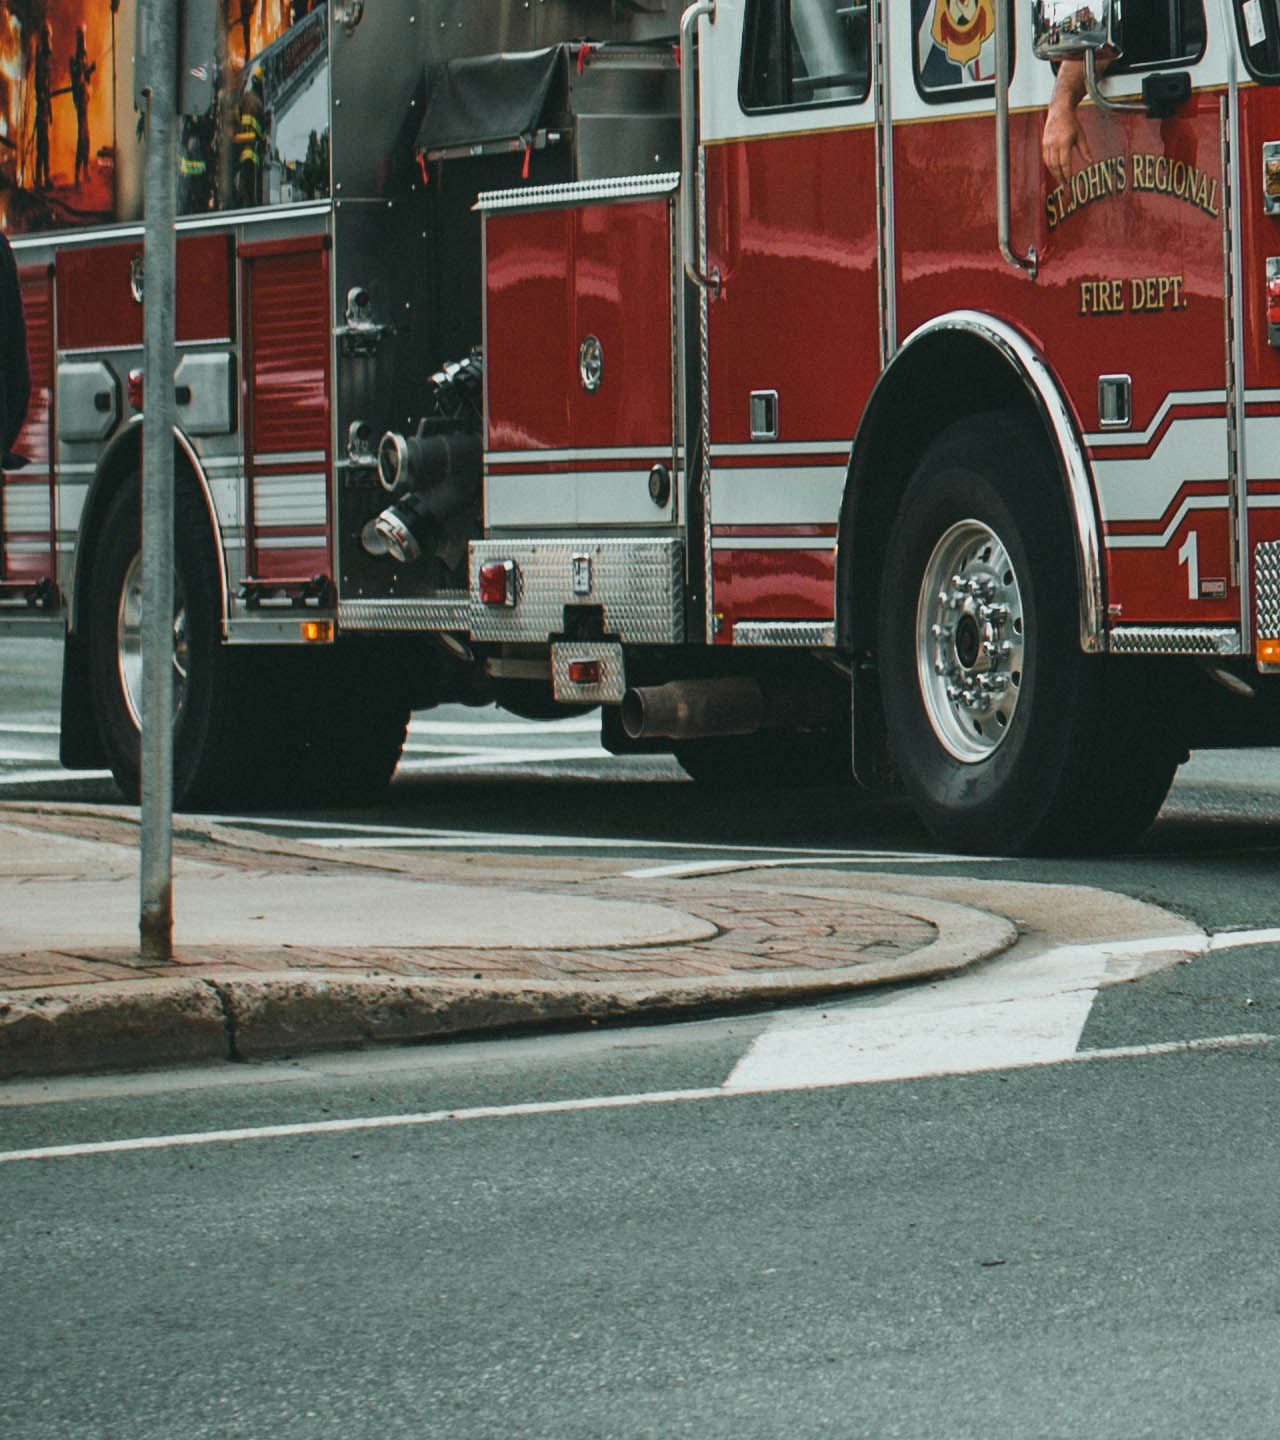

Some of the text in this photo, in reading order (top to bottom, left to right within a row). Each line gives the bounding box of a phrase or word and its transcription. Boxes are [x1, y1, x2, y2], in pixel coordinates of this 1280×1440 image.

[1132, 153, 1219, 217] REGIONAL
[1080, 275, 1187, 313] FIRE DEPT.
[1178, 530, 1199, 600] 1
